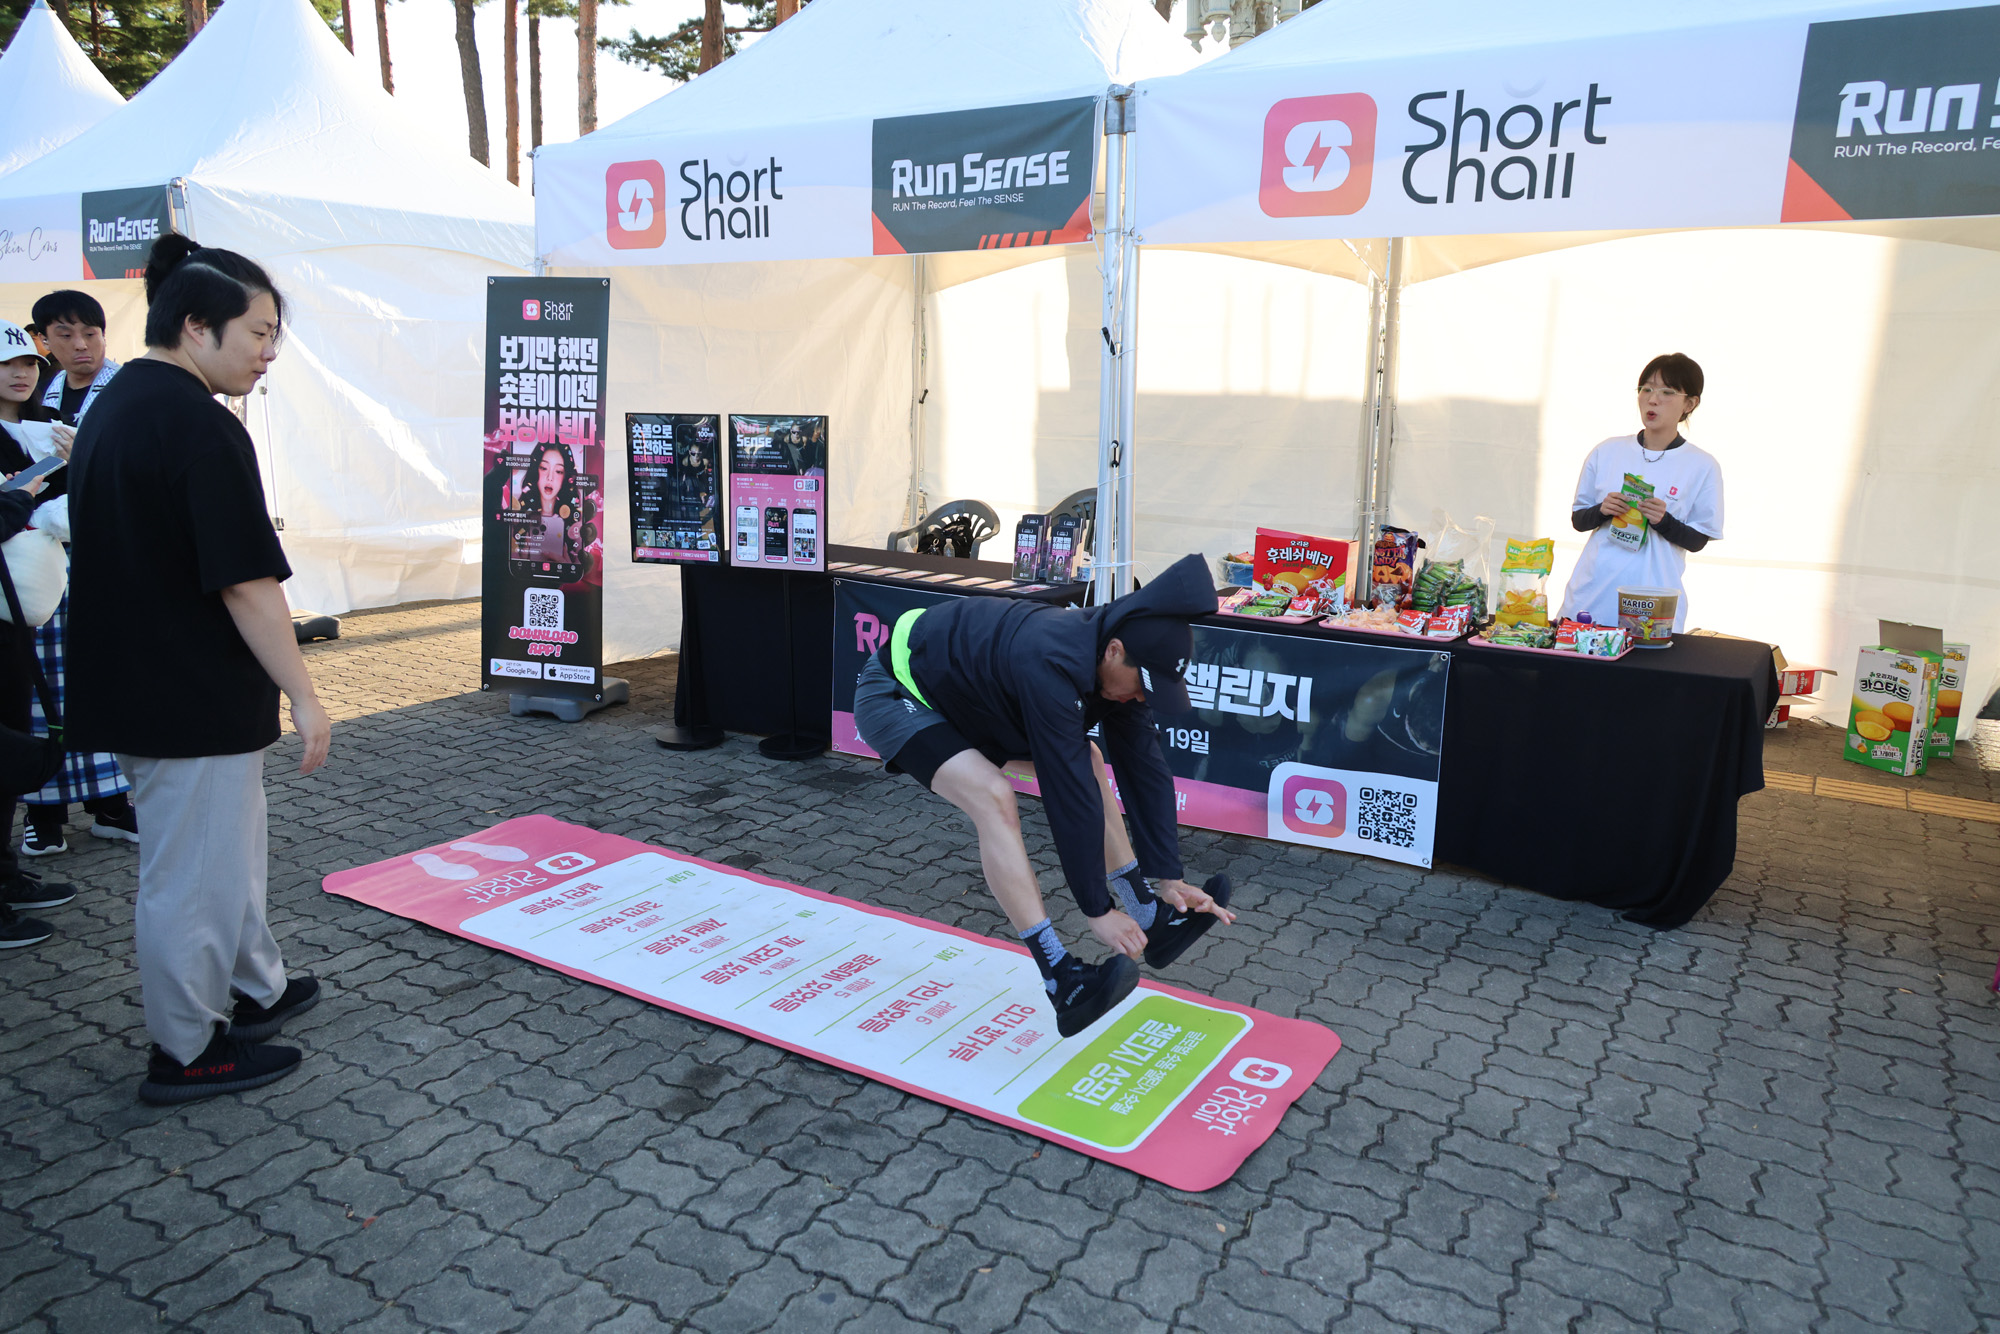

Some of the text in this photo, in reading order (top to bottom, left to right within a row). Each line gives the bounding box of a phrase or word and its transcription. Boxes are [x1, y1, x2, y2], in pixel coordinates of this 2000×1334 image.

[1405, 82, 1612, 153] Short
[1834, 144, 1871, 159] RUN
[1876, 142, 1907, 156] The
[1911, 138, 1977, 154] Record,
[680, 156, 783, 204] Short
[892, 193, 1024, 212] RUN The Record, Feel The SENSE
[544, 301, 574, 313] Short
[4, 327, 27, 346] NY
[500, 335, 599, 373] 보기만 했던
[500, 372, 598, 409] 숏폼이 이젠
[500, 408, 597, 446] 보상이 된다
[632, 423, 673, 440] 숏폼으로
[633, 440, 673, 456] 도전하는
[1622, 598, 1655, 609] HARIBO
[509, 626, 578, 644] DOWNLOAD
[506, 666, 538, 676] Google Play
[560, 672, 590, 681] App Store
[1876, 672, 1899, 682] 오리지널
[1860, 679, 1911, 700] 카스타드
[666, 871, 696, 883] 0.5M
[579, 901, 663, 933] 잠깐 떴음
[795, 910, 816, 918] 1M
[643, 918, 727, 954] 제법 떴음
[698, 935, 730, 949] 레벨
[701, 936, 805, 984] 꽤 오래 떴음
[769, 957, 800, 970] 레벨
[934, 946, 963, 961] 1.5M
[769, 954, 881, 1012] 공중에 있었음
[844, 978, 875, 992] 레벨
[857, 1000, 921, 1032] 날았음
[916, 1001, 957, 1025] 레벨 6
[949, 1004, 1036, 1061] 인간 캥거루
[1004, 1030, 1044, 1055] 레벨 7
[1066, 1019, 1182, 1106] 챌린지 성공!
[1109, 1031, 1207, 1115] 글로벌 숏폼 챌린지 숏챌
[1208, 1088, 1267, 1135] Short
